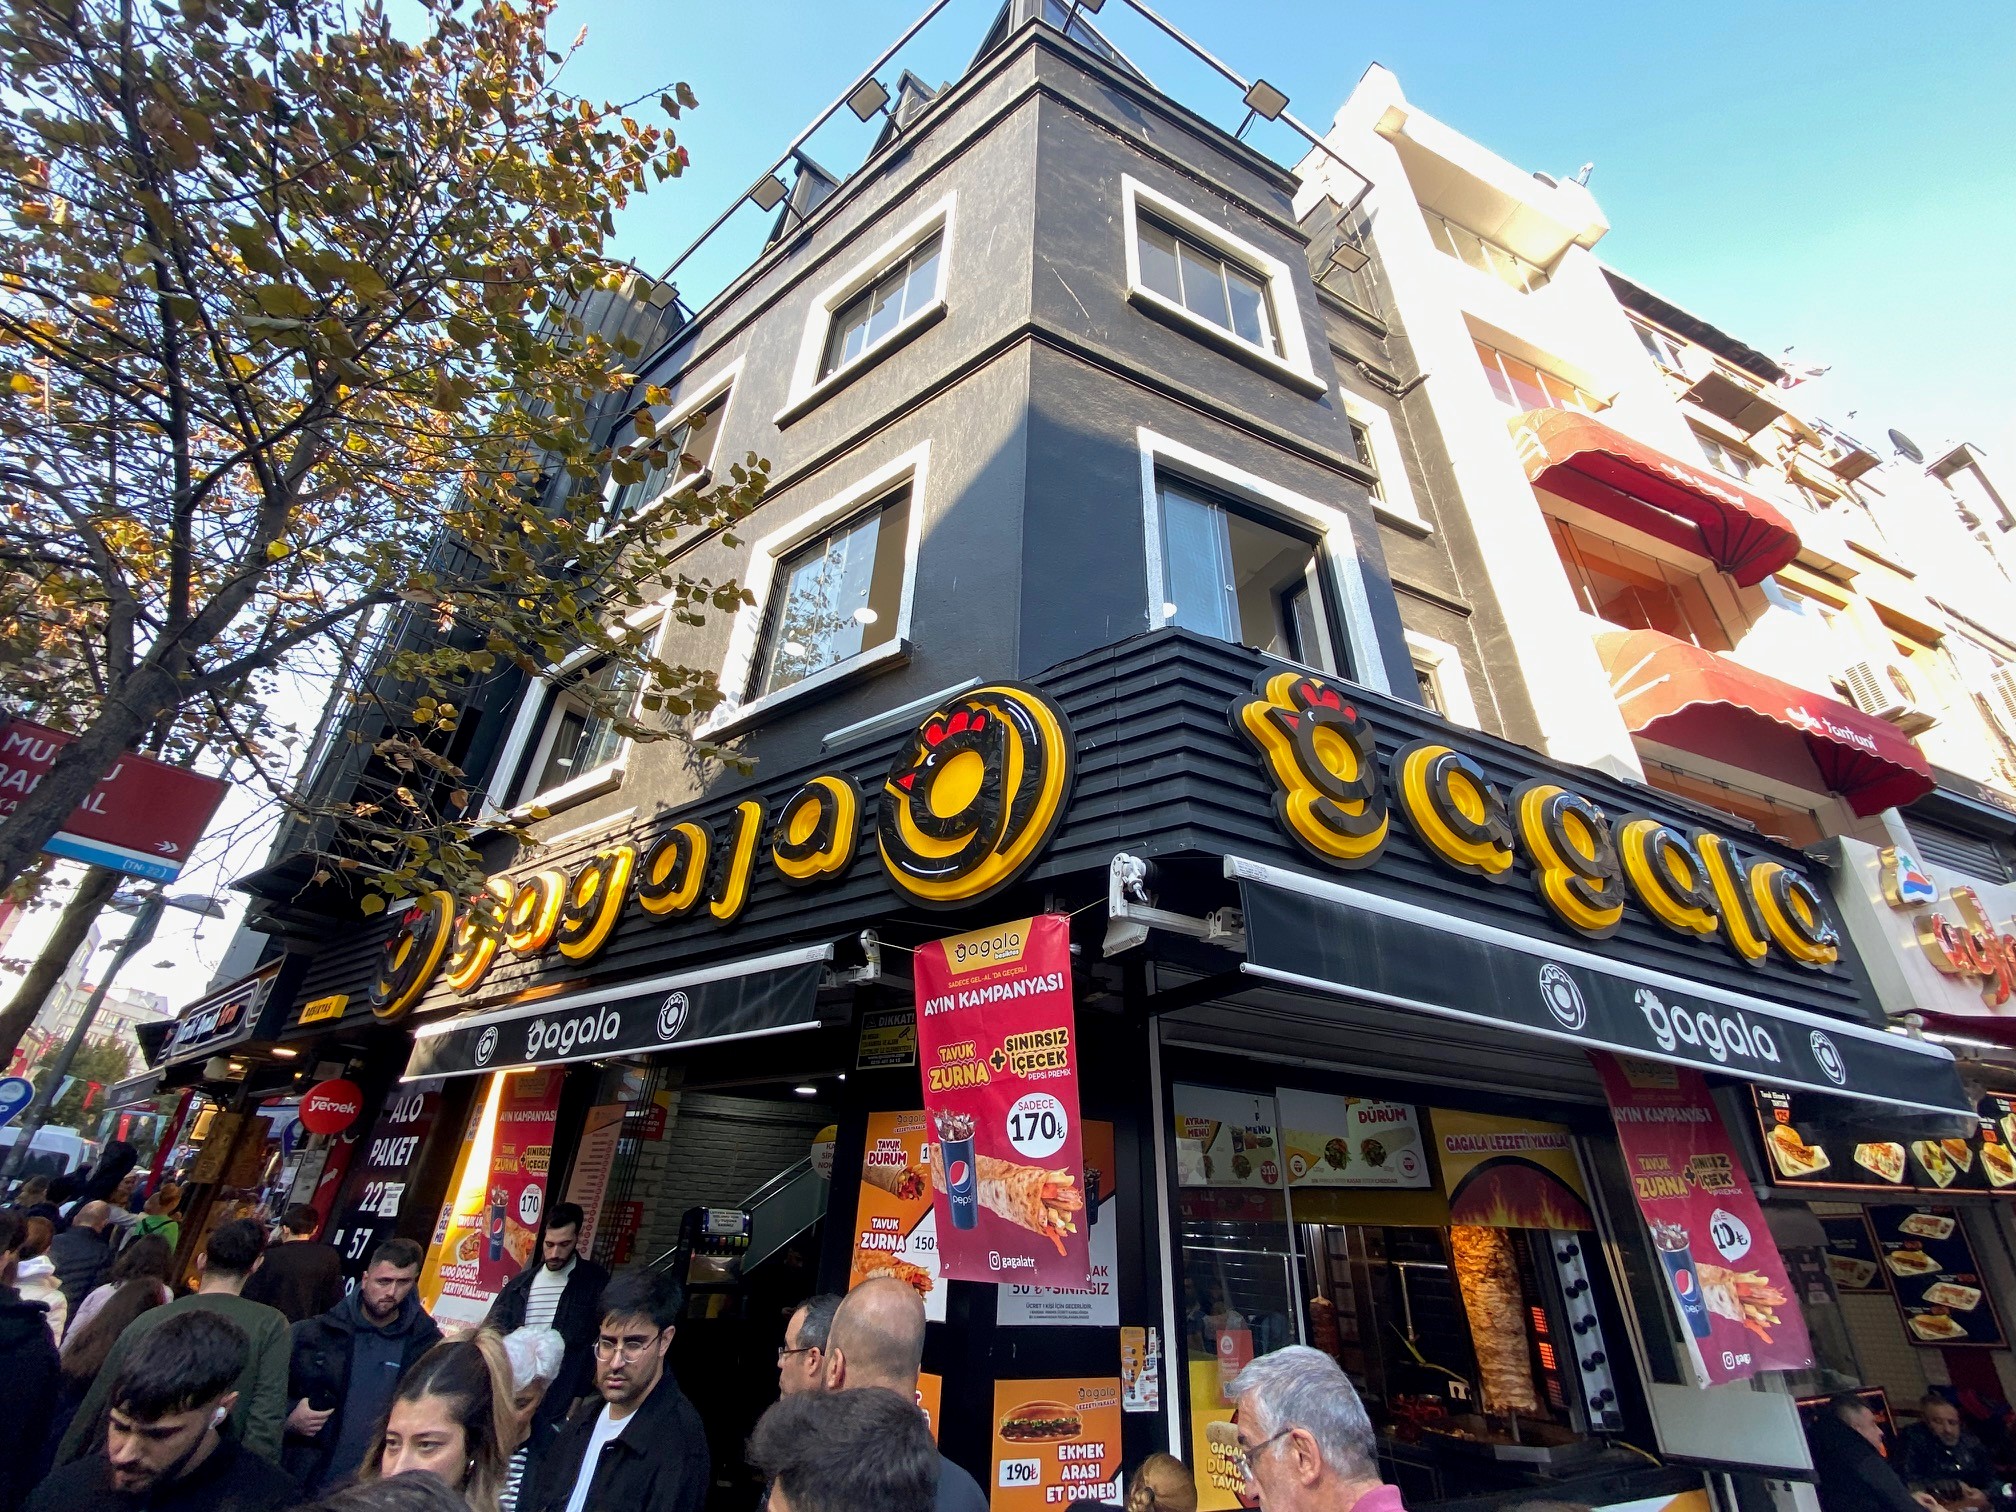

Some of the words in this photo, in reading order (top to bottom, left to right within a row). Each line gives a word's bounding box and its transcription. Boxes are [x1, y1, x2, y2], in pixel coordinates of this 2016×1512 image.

[1232, 667, 1839, 966] gagala
[446, 772, 863, 996] gagala
[954, 932, 1020, 962] gagala
[948, 979, 970, 988] SADECE
[1002, 964, 1028, 978] GEÇERLİ
[924, 994, 955, 1017] AYIN
[958, 972, 1064, 1009] KAMPANYASI
[526, 1007, 621, 1060] gagala
[1635, 987, 1781, 1063] gagala
[939, 1041, 975, 1062] TAVUK
[1006, 1030, 1068, 1052] SINIRSIZ
[929, 1062, 990, 1091] ZURNA
[1011, 1051, 1066, 1076] İÇECEK
[308, 1100, 356, 1114] yemek
[389, 1093, 424, 1123] ALO
[500, 1111, 513, 1122] AYIN
[513, 1110, 557, 1122] KAMPANYASI
[1018, 1099, 1055, 1111] SADECE
[1358, 1105, 1407, 1124] DÜRÜM
[1614, 1107, 1642, 1123] AYIN
[368, 1136, 419, 1166] PAKET
[878, 1140, 900, 1150] TAVUK
[1445, 1134, 1489, 1153] GAGALA
[1493, 1130, 1529, 1152] LEZZETİ
[868, 1149, 907, 1166] DÜRÜM
[1636, 1175, 1689, 1199] ZURNA
[521, 1196, 539, 1213] 170
[871, 1217, 899, 1230] TAVUK
[861, 1232, 906, 1252] ZURNA
[1002, 1255, 1036, 1269] gagalatr
[1057, 1443, 1104, 1461] EKMEK
[1061, 1464, 1100, 1481] ARASI
[1046, 1486, 1066, 1503] ET
[1069, 1480, 1117, 1501] DÖNER
[1211, 1474, 1246, 1496] TAVUK
